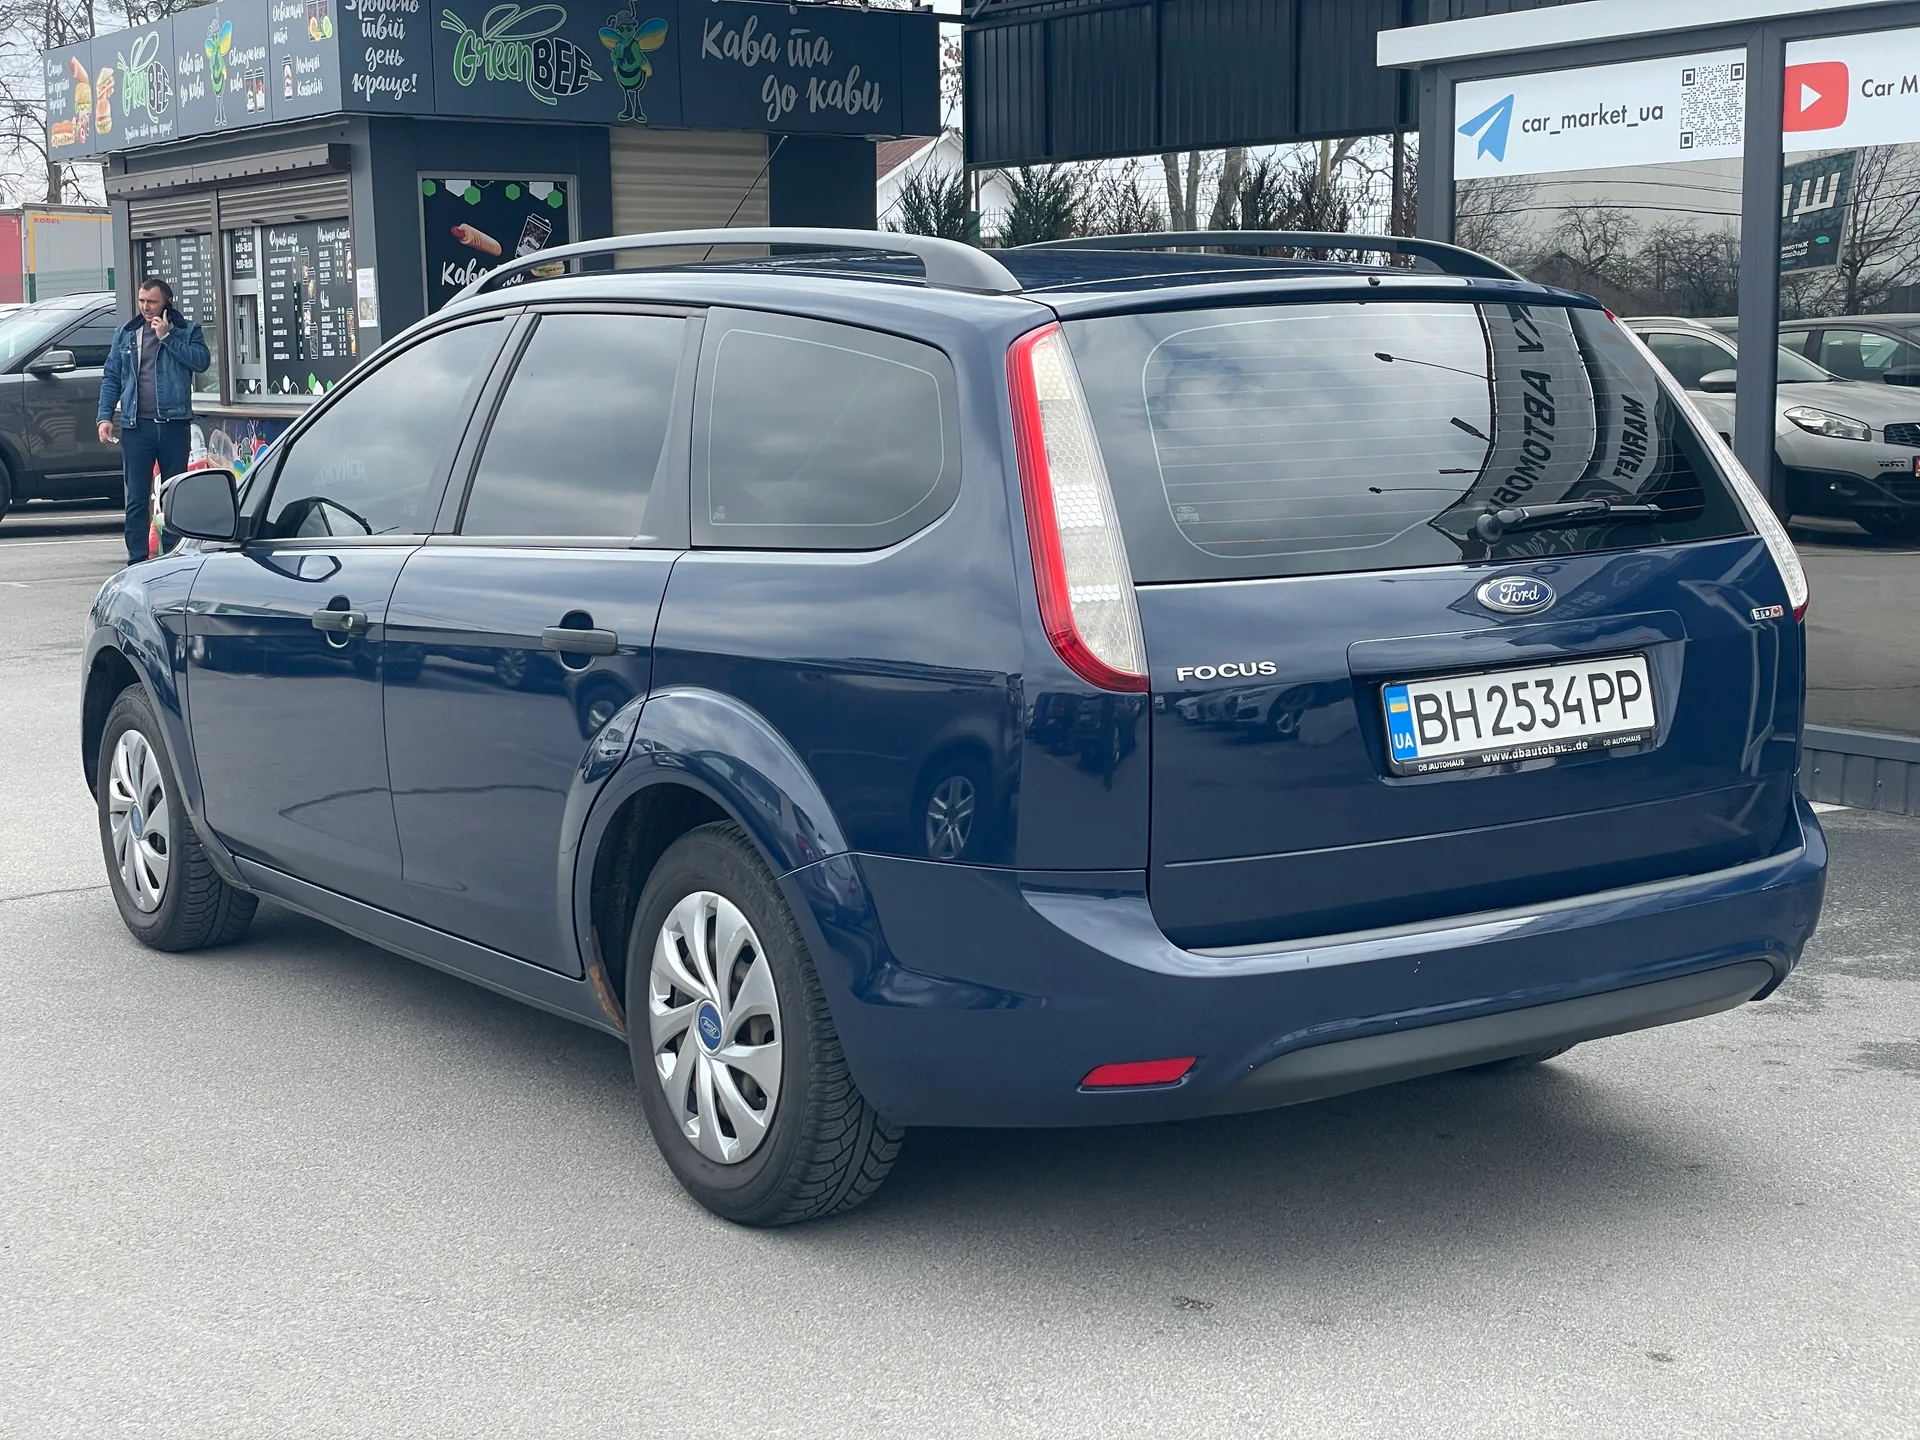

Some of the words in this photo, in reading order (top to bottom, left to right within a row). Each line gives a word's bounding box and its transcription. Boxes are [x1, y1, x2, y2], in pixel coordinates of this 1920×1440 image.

[362, 13, 406, 40] твій
[702, 15, 781, 67] Кава
[787, 28, 833, 68] та
[364, 46, 405, 72] день
[351, 73, 418, 102] краще!
[762, 74, 798, 122] до
[806, 64, 883, 115] кави
[1861, 79, 1895, 99] Car
[1522, 103, 1664, 135] car_market_ua
[1499, 581, 1541, 604] Ford
[1176, 661, 1277, 681] FOCUS
[1394, 732, 1415, 749] UA
[1428, 758, 1465, 771] AUTOHAUS
